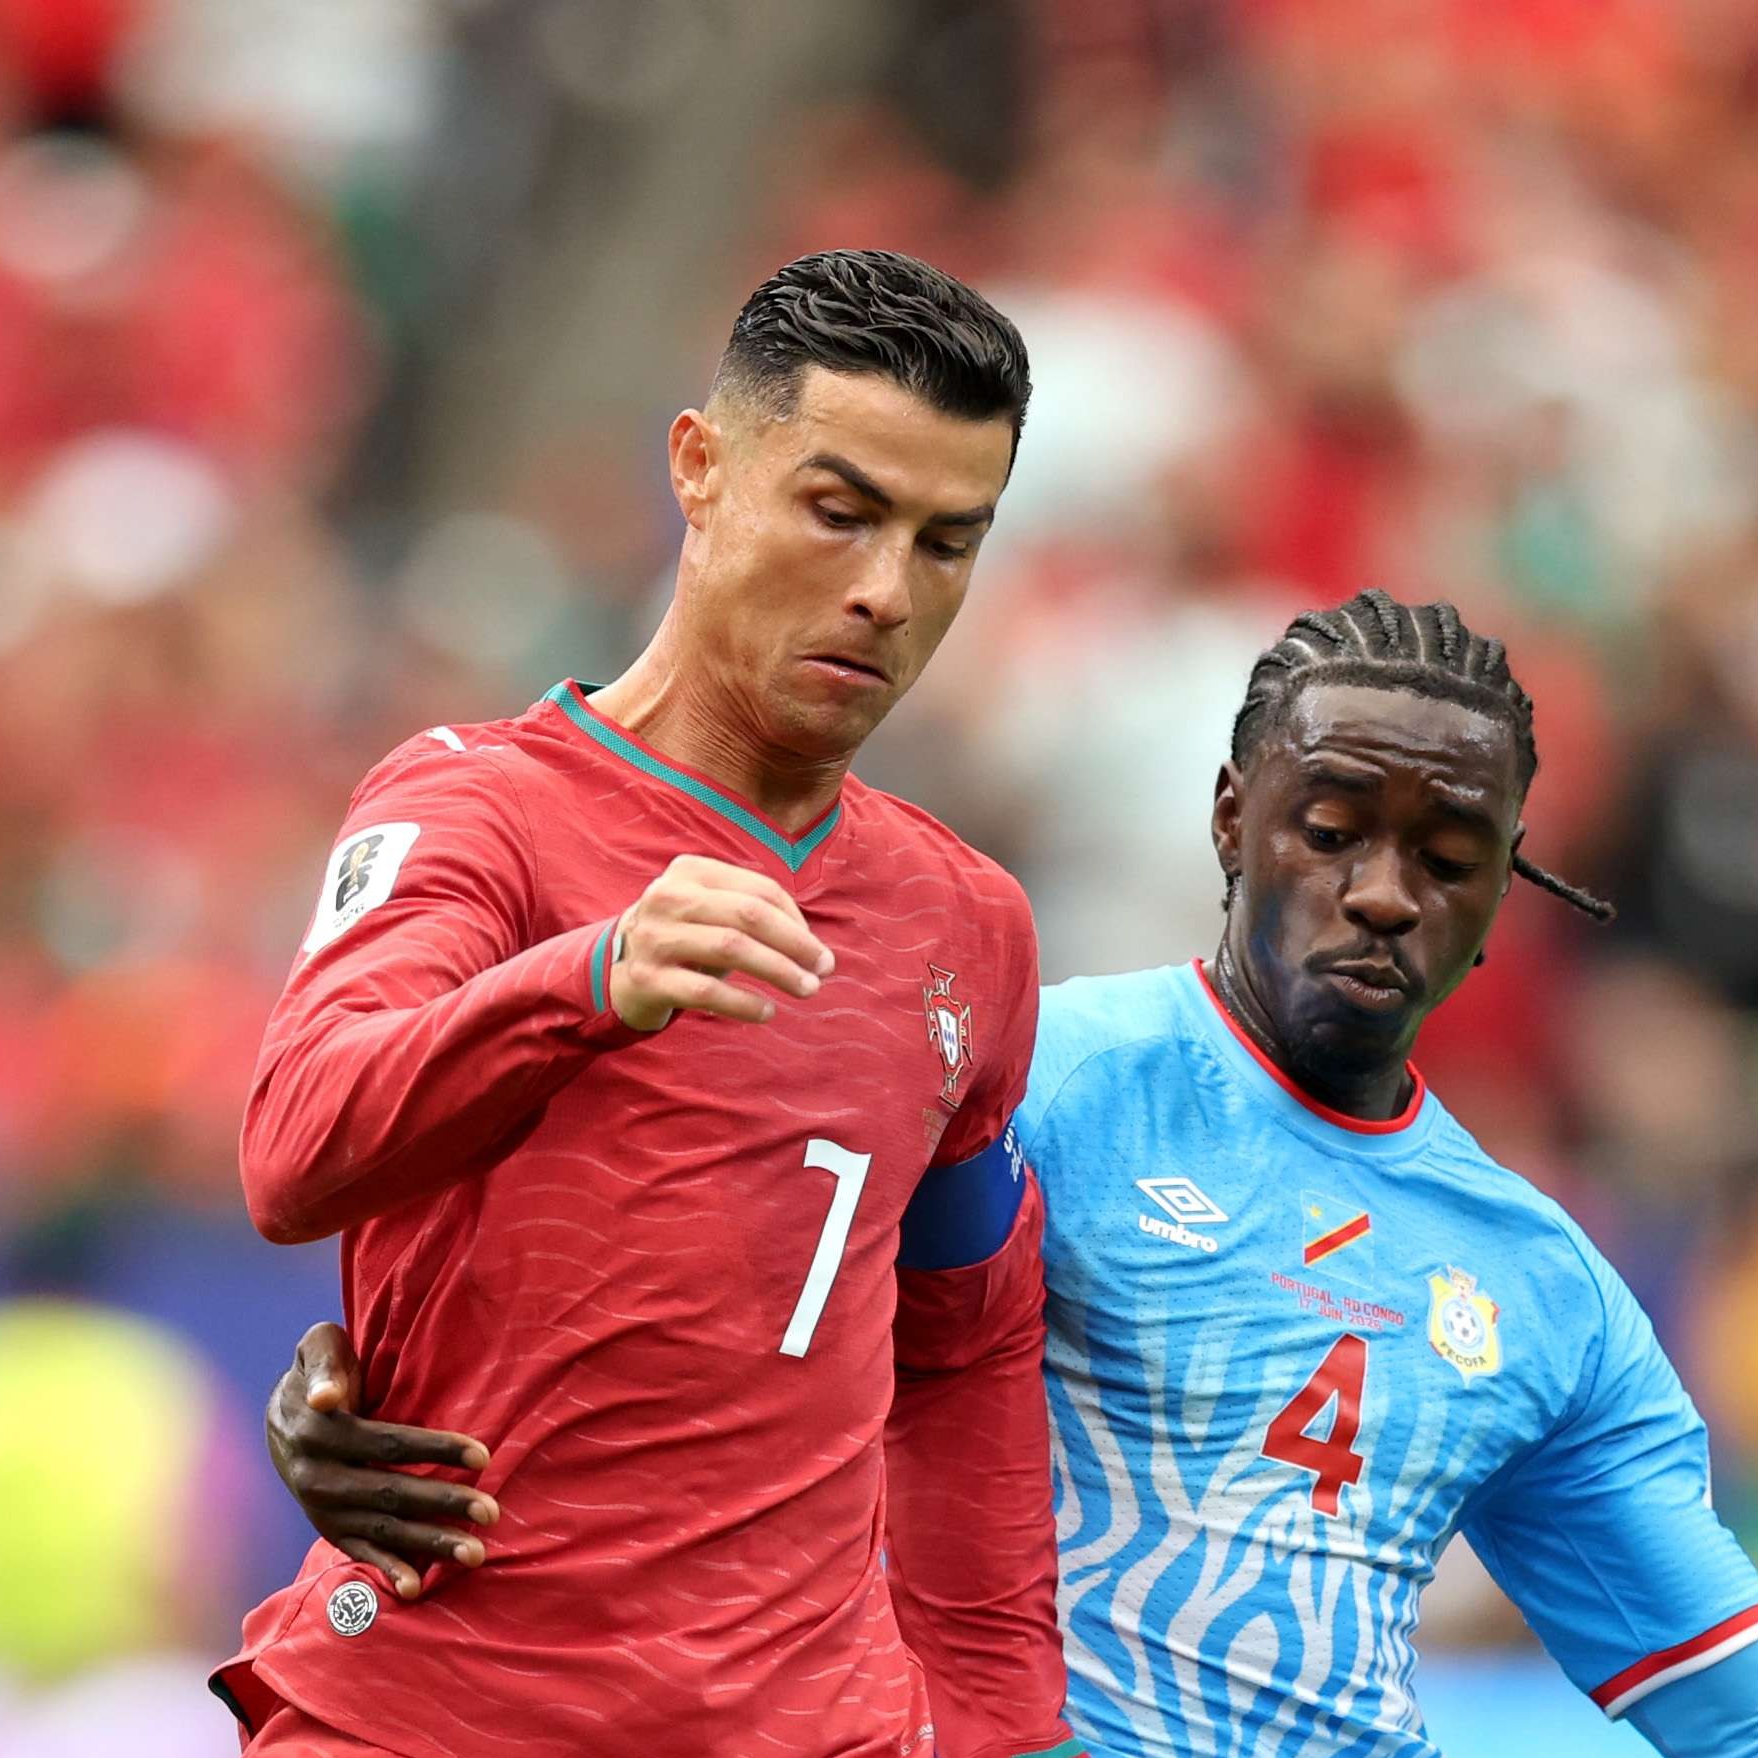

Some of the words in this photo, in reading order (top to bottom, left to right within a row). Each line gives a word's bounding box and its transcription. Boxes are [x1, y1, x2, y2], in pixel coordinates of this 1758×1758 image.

[779, 1138, 872, 1359] 7
[1138, 1213, 1219, 1254] umbro
[1271, 1271, 1334, 1305] PORTUGAL
[1363, 1302, 1404, 1326] CONGO
[1440, 1341, 1488, 1368] FECOFA
[1259, 1332, 1369, 1518] 4
